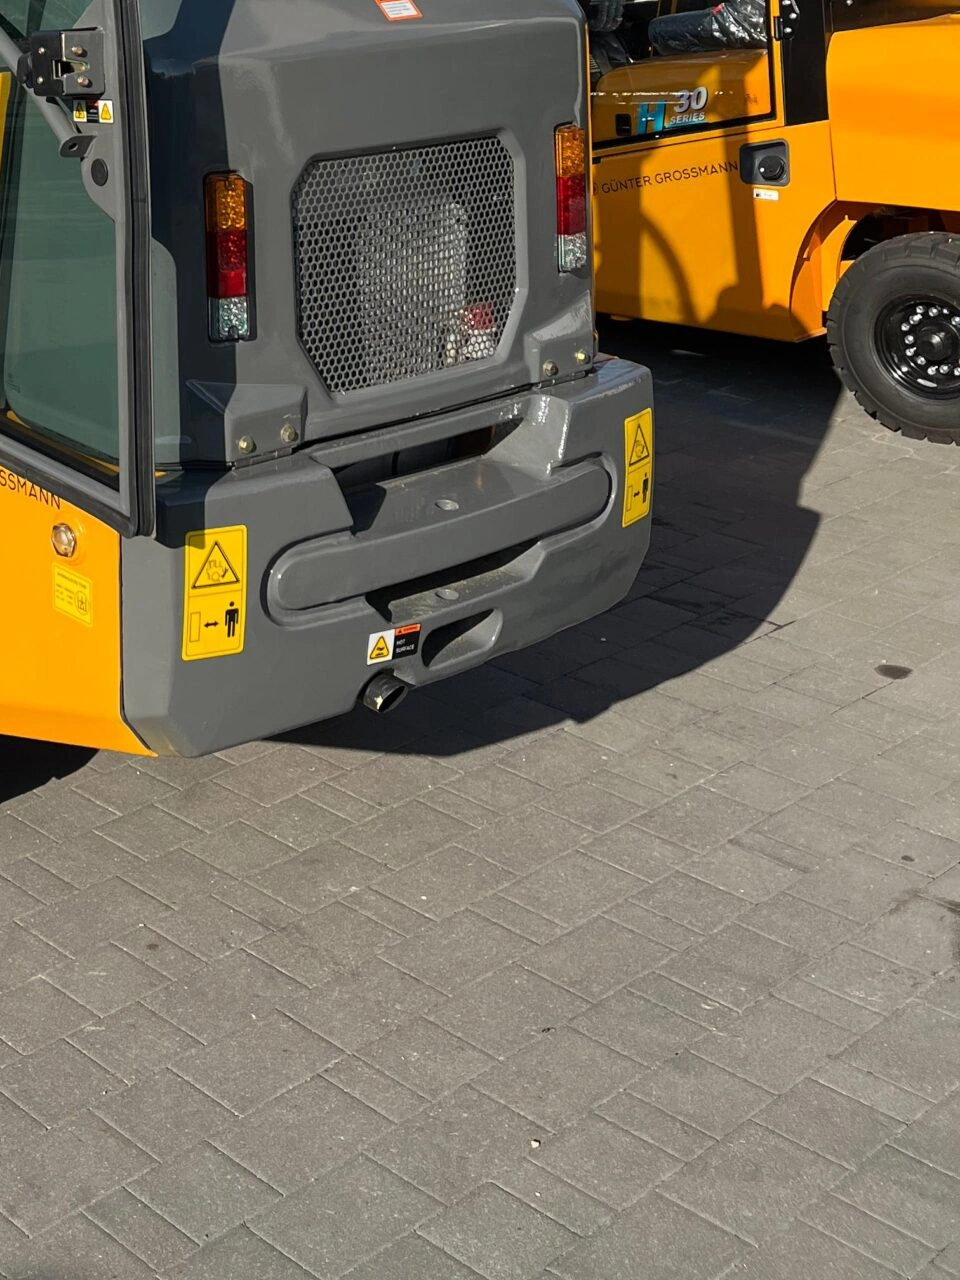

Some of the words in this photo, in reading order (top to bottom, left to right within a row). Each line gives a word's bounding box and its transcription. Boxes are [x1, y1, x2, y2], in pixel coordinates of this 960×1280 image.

[674, 86, 708, 113] 30
[669, 111, 706, 125] SERIES
[601, 175, 652, 194] GÜNTER
[654, 160, 739, 184] GROSSMANN
